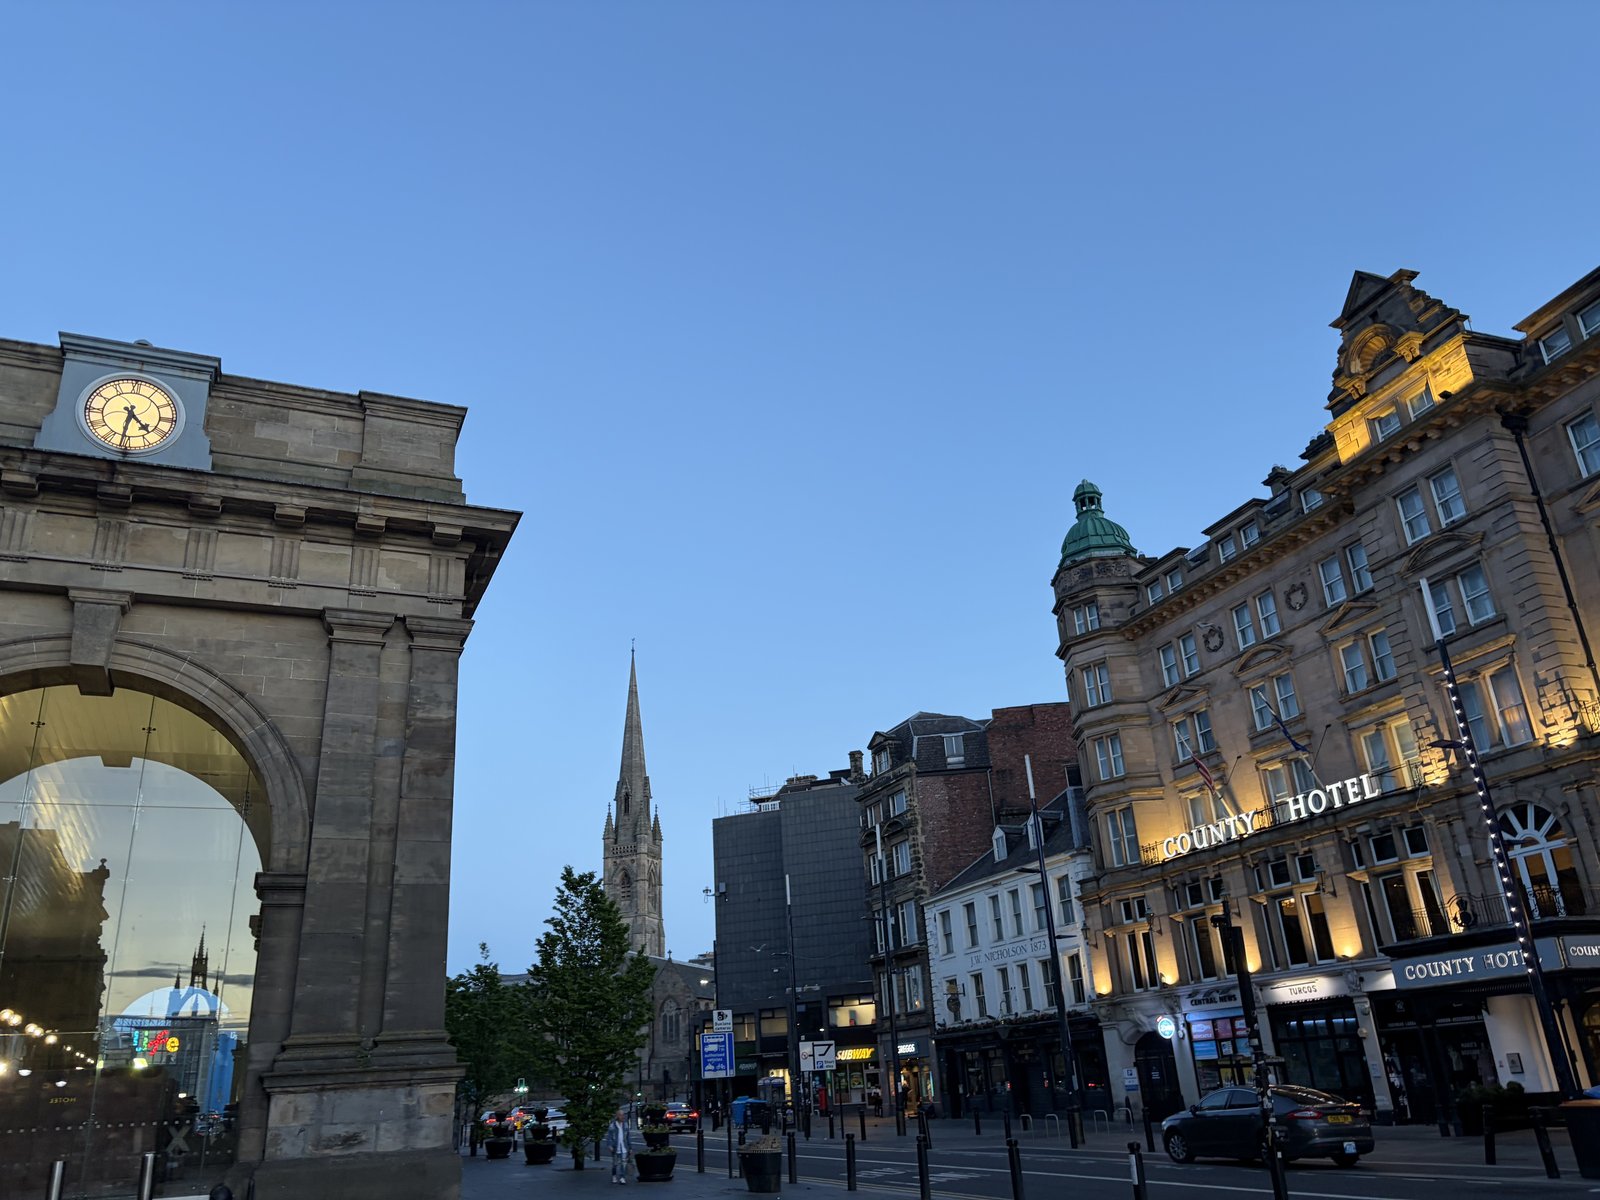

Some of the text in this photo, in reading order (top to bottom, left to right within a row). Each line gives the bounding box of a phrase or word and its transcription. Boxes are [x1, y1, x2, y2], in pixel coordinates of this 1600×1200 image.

[1163, 773, 1381, 858] COUNTY HOTEL
[970, 940, 1047, 968] J.W. NICHOLSON 1873
[1405, 949, 1542, 980] COUNTY HOT
[1288, 984, 1318, 996] TURCOS
[1190, 994, 1238, 1007] CENTRAL NEWS
[836, 1048, 874, 1060] SUBWAY
[897, 1043, 916, 1054] REGGS
